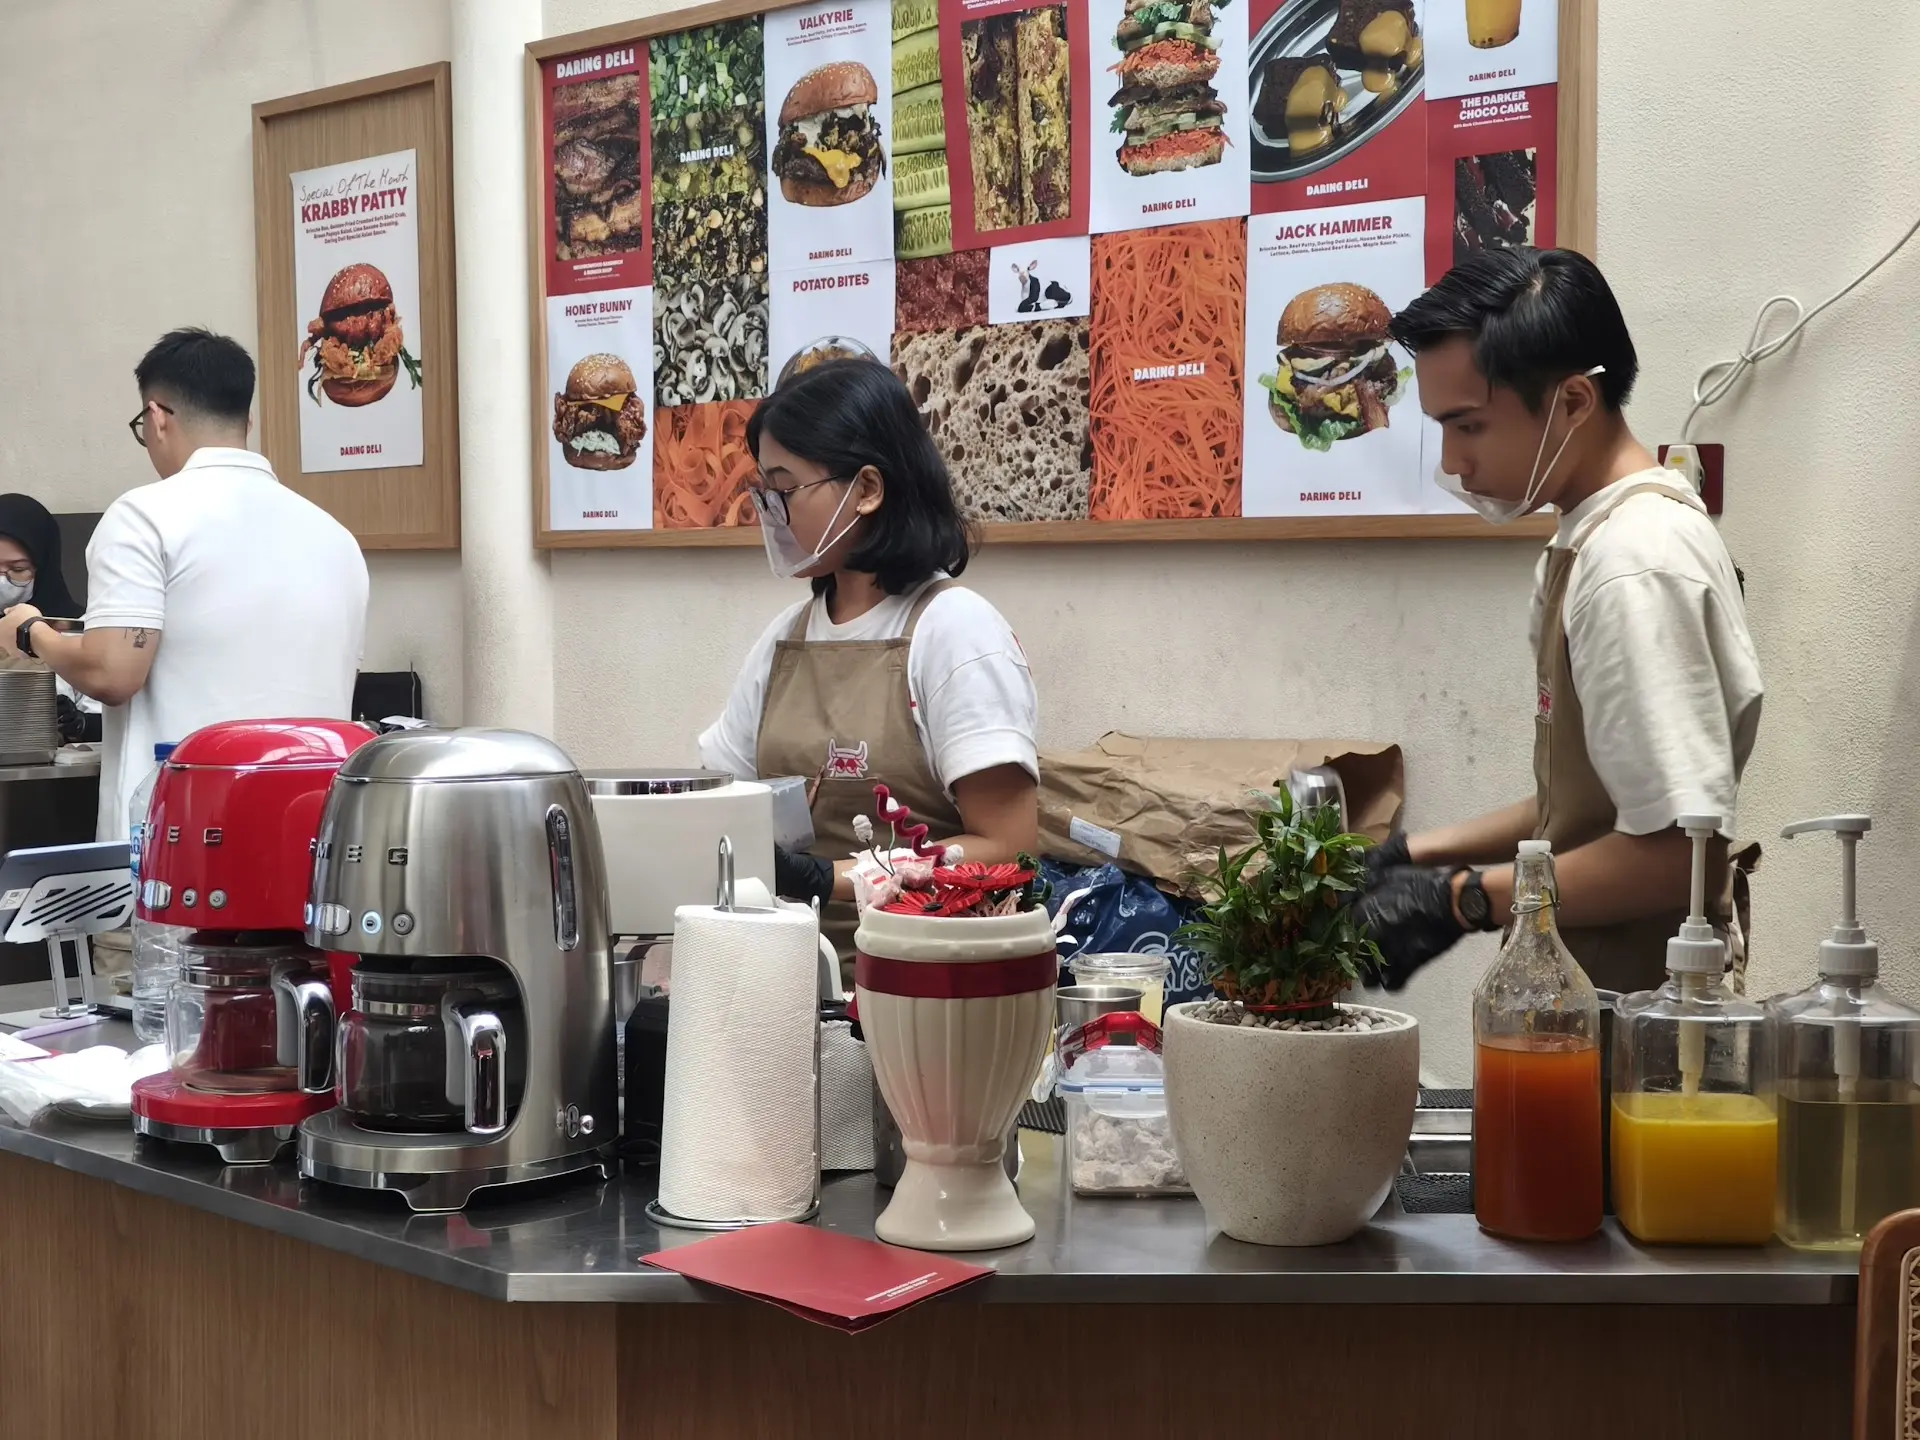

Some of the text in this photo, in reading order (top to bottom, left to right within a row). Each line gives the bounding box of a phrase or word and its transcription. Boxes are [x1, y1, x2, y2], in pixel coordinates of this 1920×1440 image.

[799, 9, 853, 30] VALKYRIE
[556, 48, 634, 78] DARING DELI
[1468, 68, 1516, 82] DARING DELI
[1460, 90, 1526, 108] THE DARKER
[1459, 102, 1530, 120] CHOCO CAKE
[680, 144, 734, 162] DARING DELI
[300, 164, 410, 207] Special Of The Month
[1306, 178, 1368, 196] DARING DELI
[302, 186, 408, 224] KRABBY PATTY
[1142, 198, 1196, 214] DARING DELI
[1276, 216, 1392, 240] JACK HAMMER
[808, 248, 852, 260] DARING DELI
[793, 273, 870, 292] POTATO BITES
[565, 299, 632, 316] HONEY BUNNY
[1134, 362, 1204, 380] DARING DELI
[340, 444, 382, 456] DARING DELI
[1300, 490, 1362, 502] DARING DELI
[582, 510, 618, 518] DARING DELI
[140, 820, 223, 845] MEG
